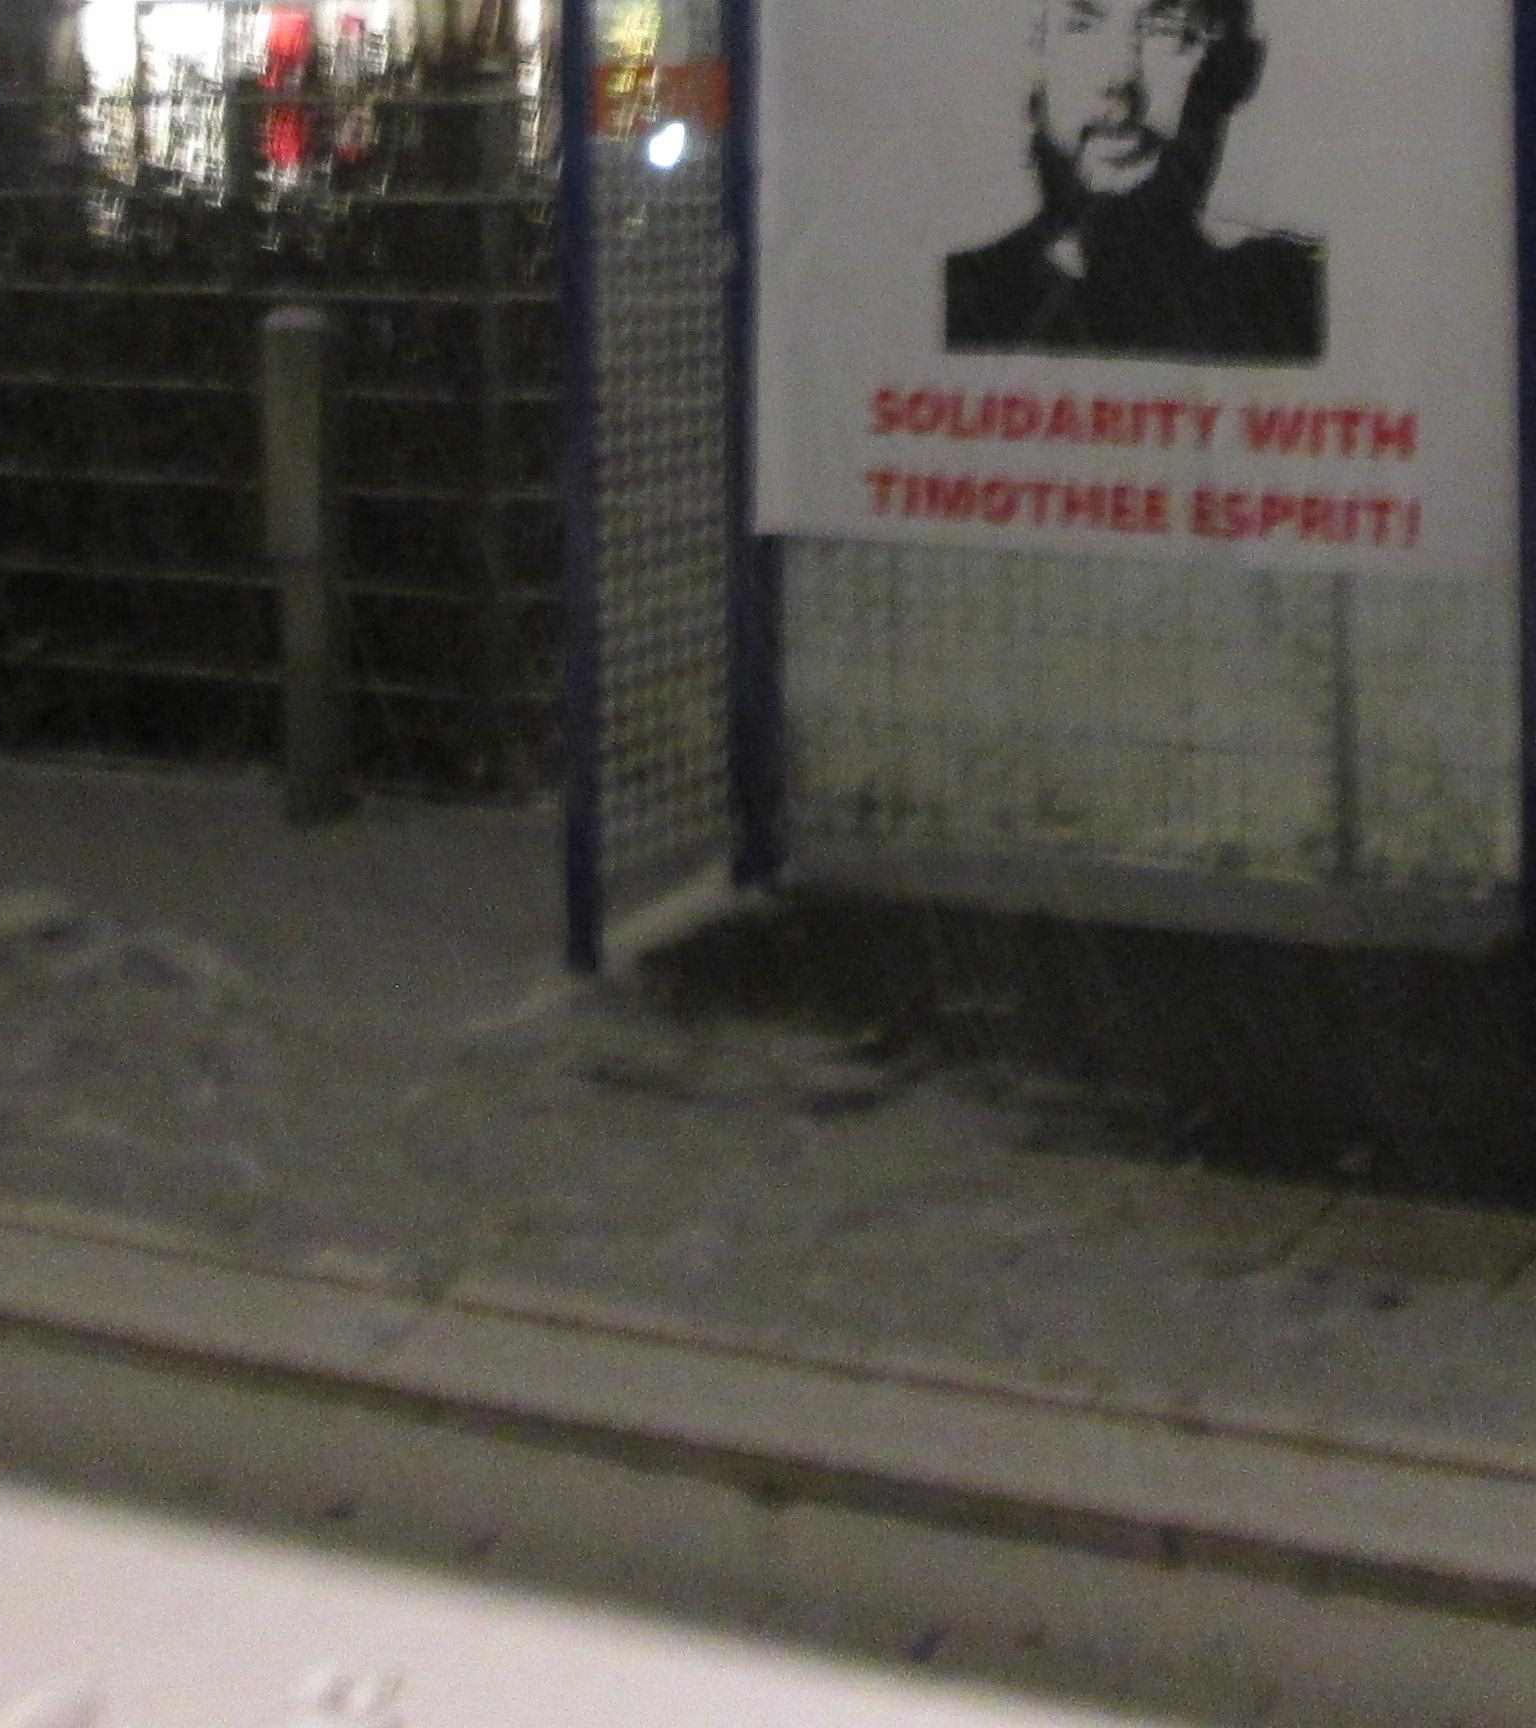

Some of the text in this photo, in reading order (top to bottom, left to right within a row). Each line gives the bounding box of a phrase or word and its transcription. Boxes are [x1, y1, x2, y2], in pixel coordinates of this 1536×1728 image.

[869, 388, 1419, 461] SOLIDARITY WITH
[1190, 486, 1422, 548] ESPRIT!
